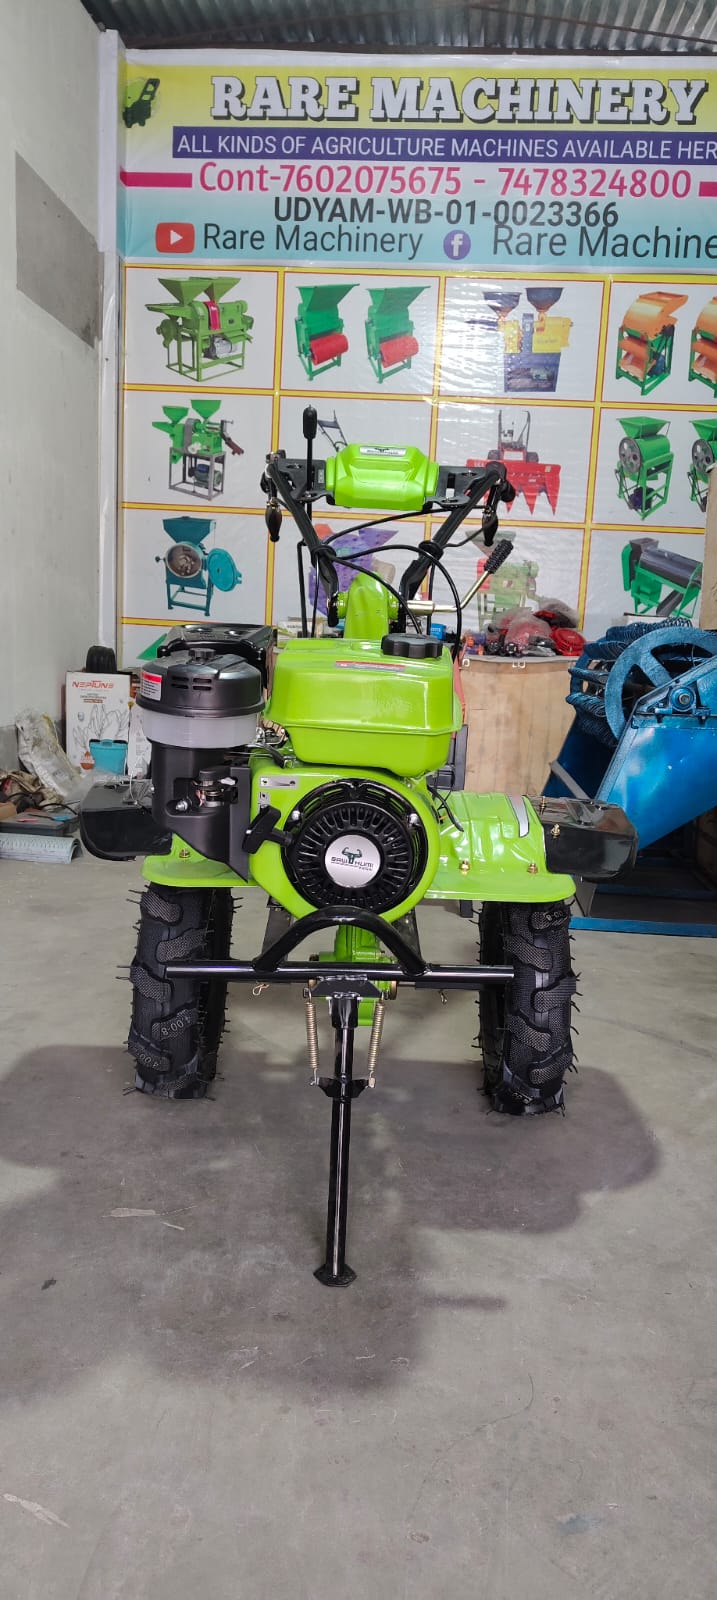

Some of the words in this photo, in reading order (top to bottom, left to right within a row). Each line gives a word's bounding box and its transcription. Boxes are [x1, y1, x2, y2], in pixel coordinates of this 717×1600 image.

[211, 76, 360, 122] RARE
[370, 76, 709, 125] MACHINERY
[177, 135, 213, 153] ALL
[218, 136, 276, 154] KINDS
[281, 136, 306, 154] OF
[311, 137, 446, 156] AGRICULTURE
[451, 138, 559, 158] MACHINES
[562, 139, 673, 159] AVAILABLE
[200, 161, 461, 195] Cont-7602075675
[498, 167, 692, 198] 7478324800
[274, 196, 619, 228] UDYAM-WB-01-0023366
[204, 223, 265, 250] Rare
[275, 224, 423, 259] Machinery
[493, 224, 567, 256] Rare
